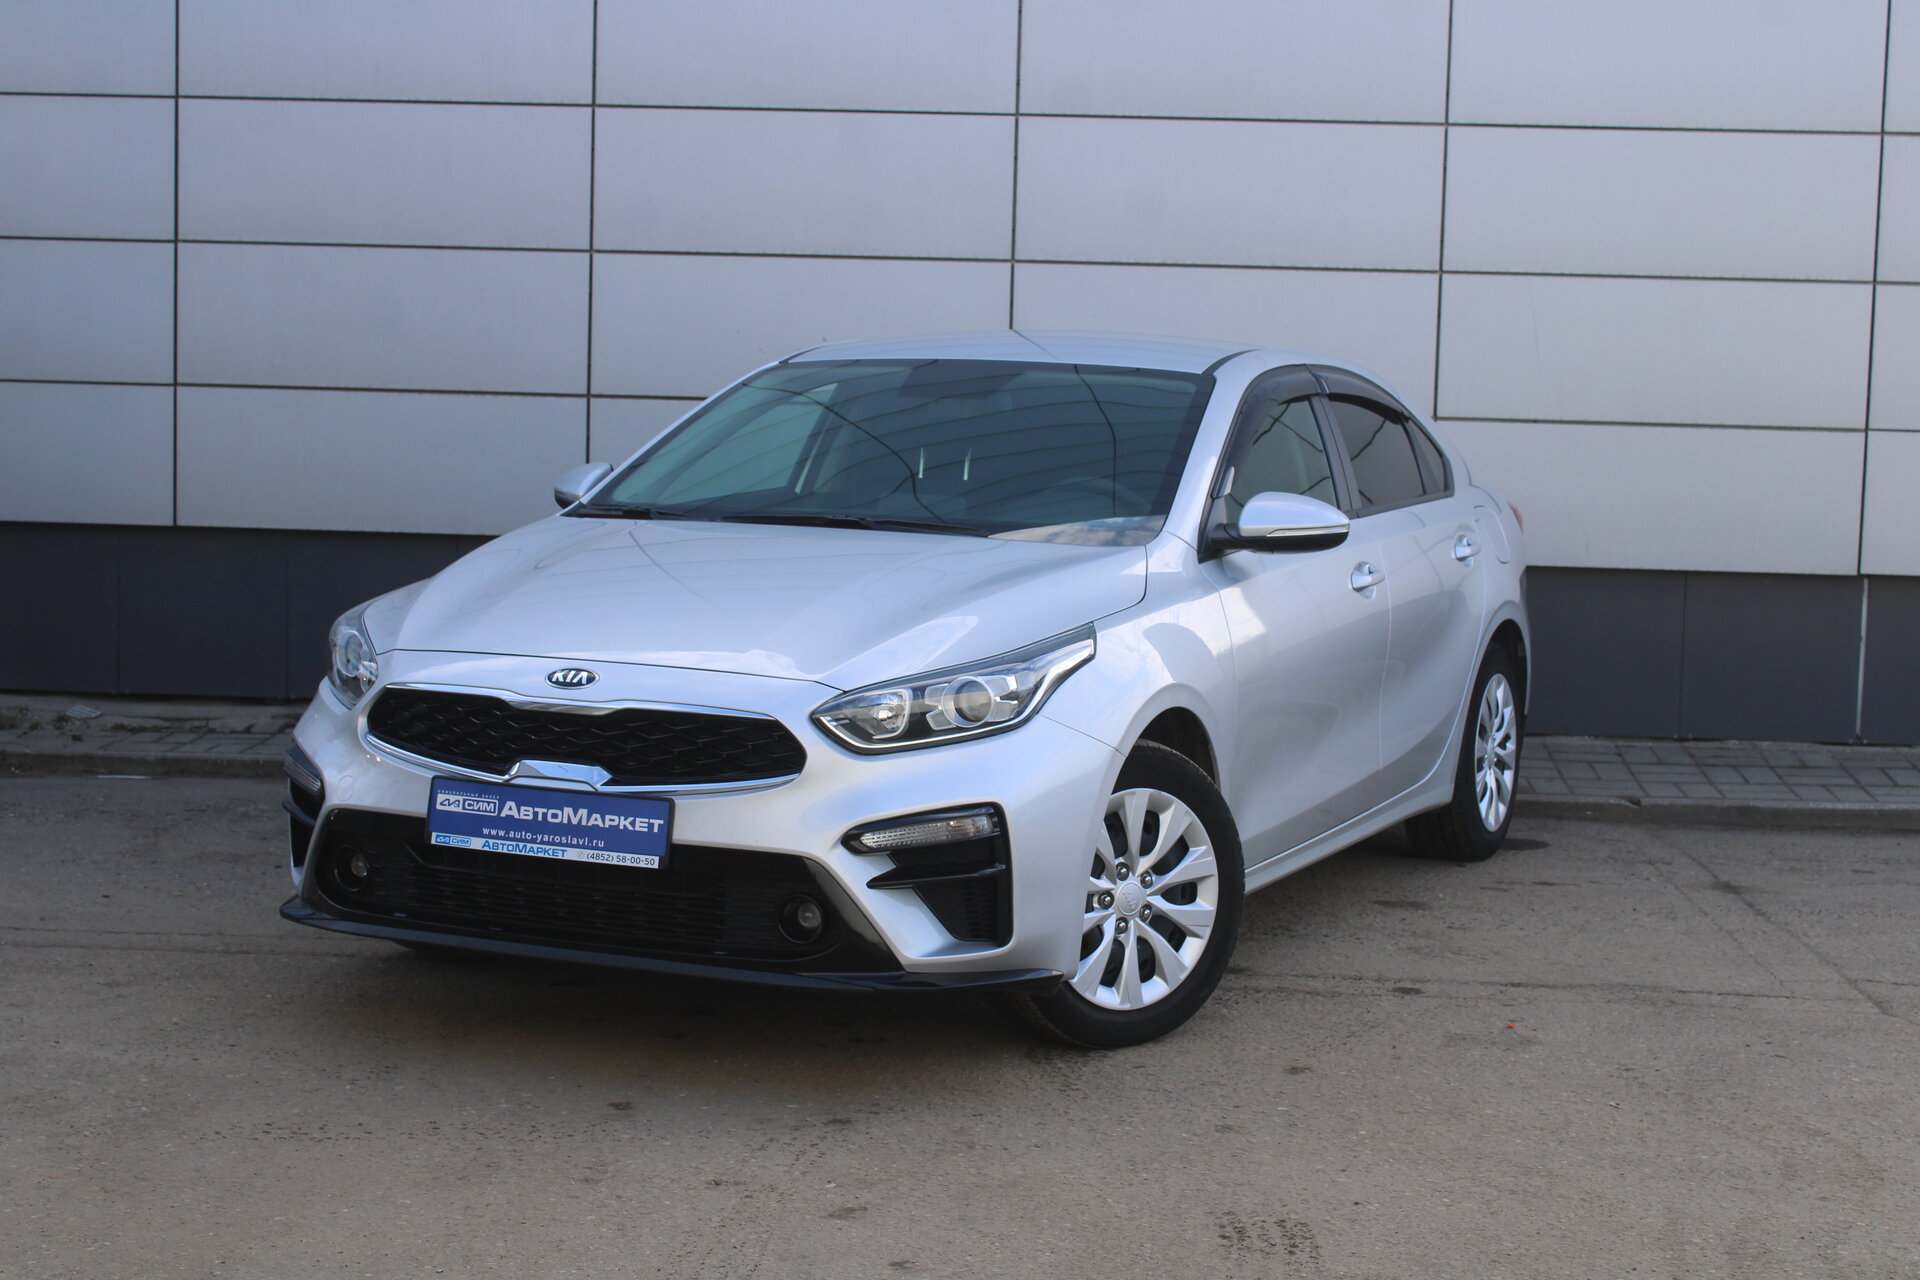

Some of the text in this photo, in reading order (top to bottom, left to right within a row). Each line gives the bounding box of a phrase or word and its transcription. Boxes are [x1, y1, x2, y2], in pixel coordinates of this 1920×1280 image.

[552, 670, 588, 684] KIA
[464, 800, 494, 812] СИМ
[482, 827, 605, 848] www.auto-yaroslavl.ru
[586, 852, 655, 866] (4852) 58-00-50
